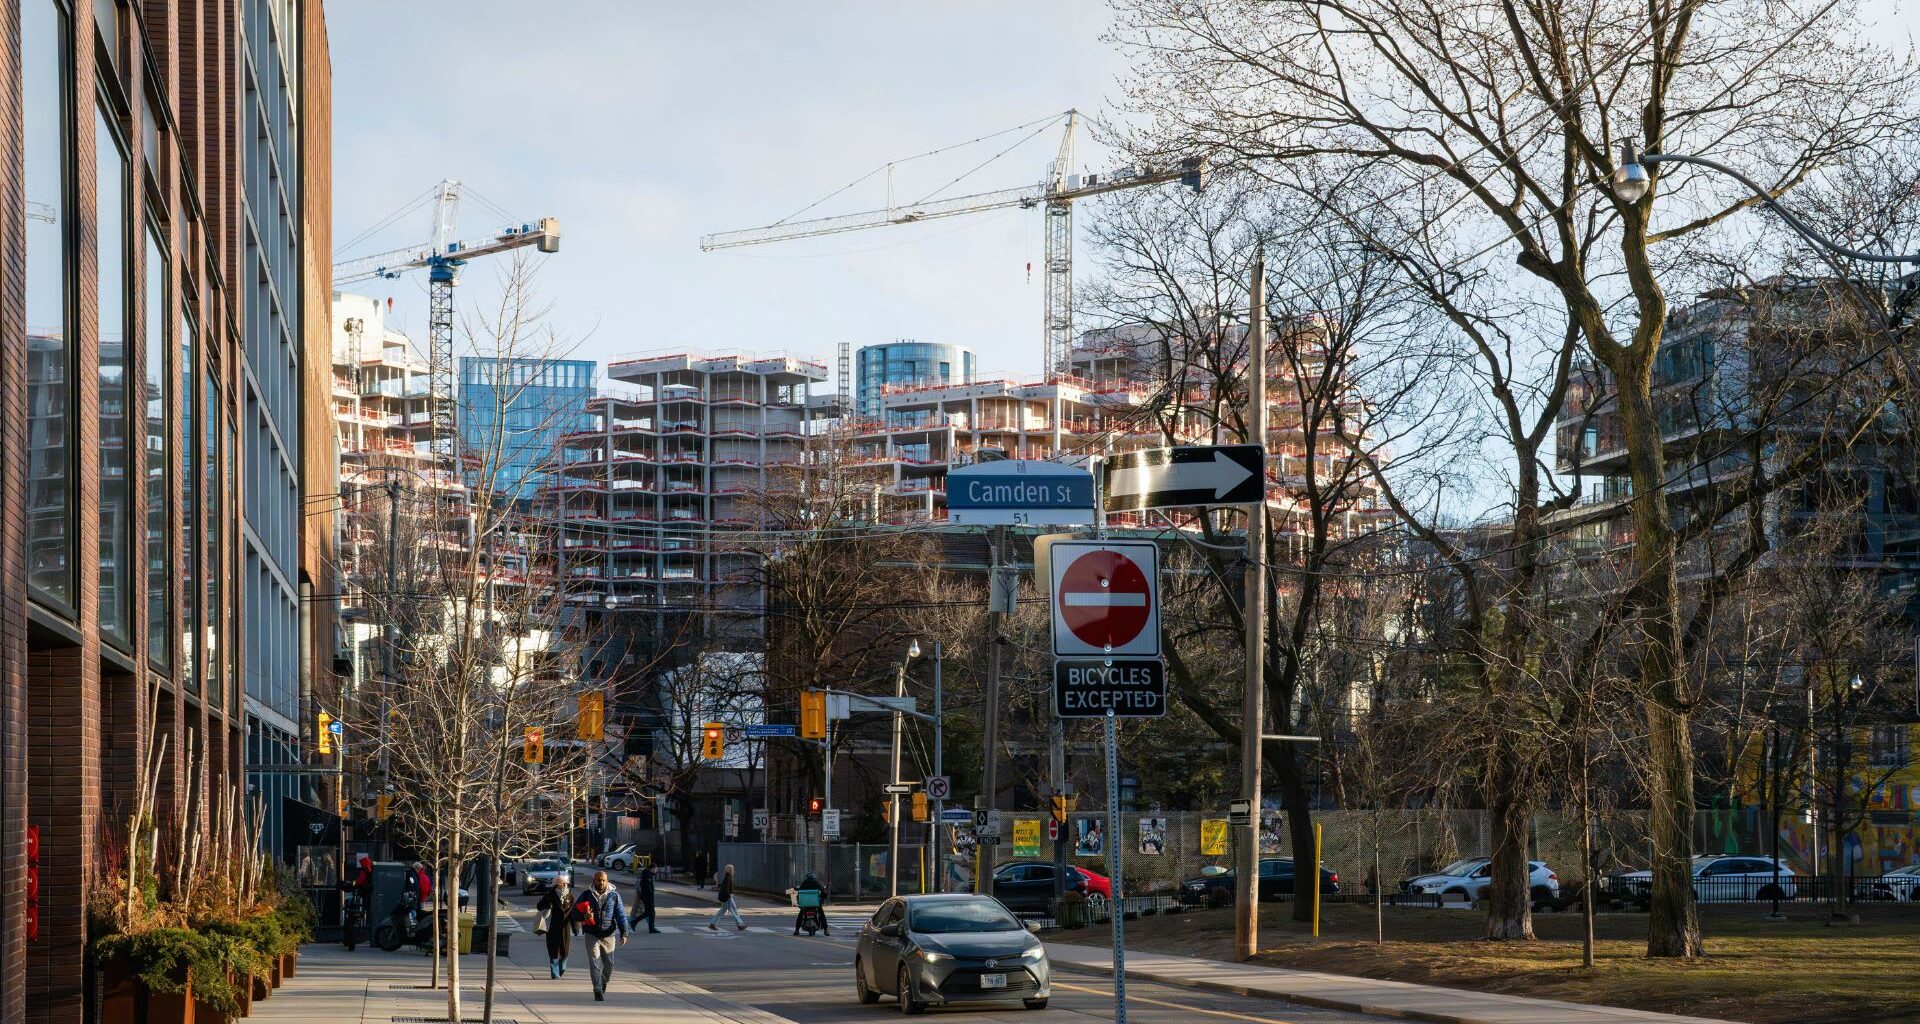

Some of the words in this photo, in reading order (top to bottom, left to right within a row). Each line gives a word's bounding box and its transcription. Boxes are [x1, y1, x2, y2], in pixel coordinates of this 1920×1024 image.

[968, 481, 1050, 503] Camden
[1056, 485, 1072, 503] St
[1013, 512, 1029, 524] 51
[1069, 668, 1152, 685] BICYCLES
[1065, 691, 1157, 708] EXCEPTED
[755, 818, 768, 826] 30
